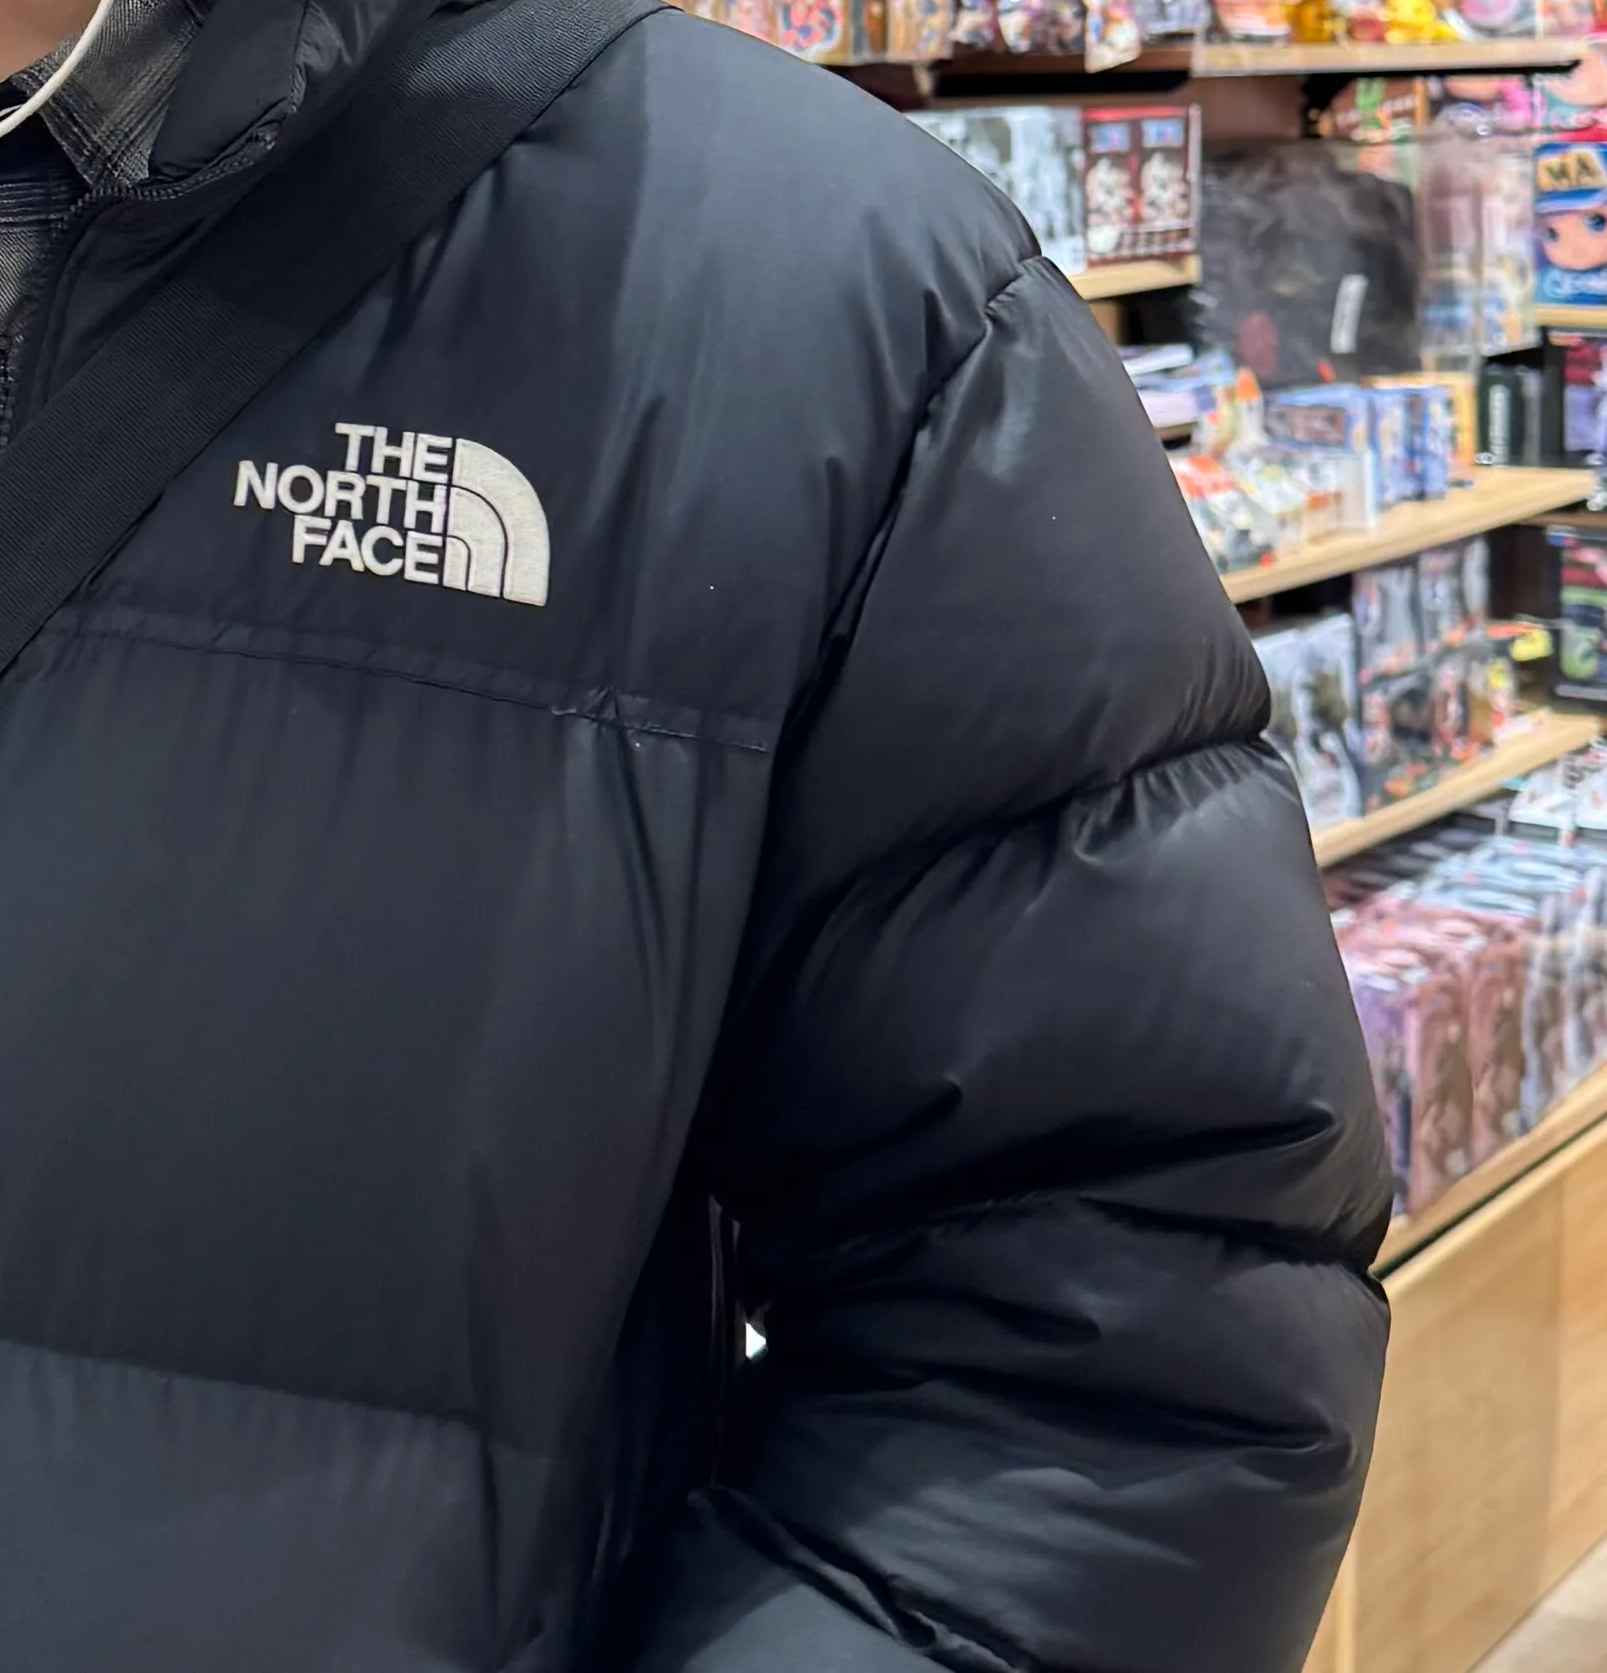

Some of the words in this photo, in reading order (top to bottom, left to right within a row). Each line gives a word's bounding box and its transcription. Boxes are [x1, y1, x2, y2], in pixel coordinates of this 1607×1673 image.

[334, 422, 453, 485] THE
[233, 459, 448, 534] NORTH
[292, 514, 444, 585] FACE
